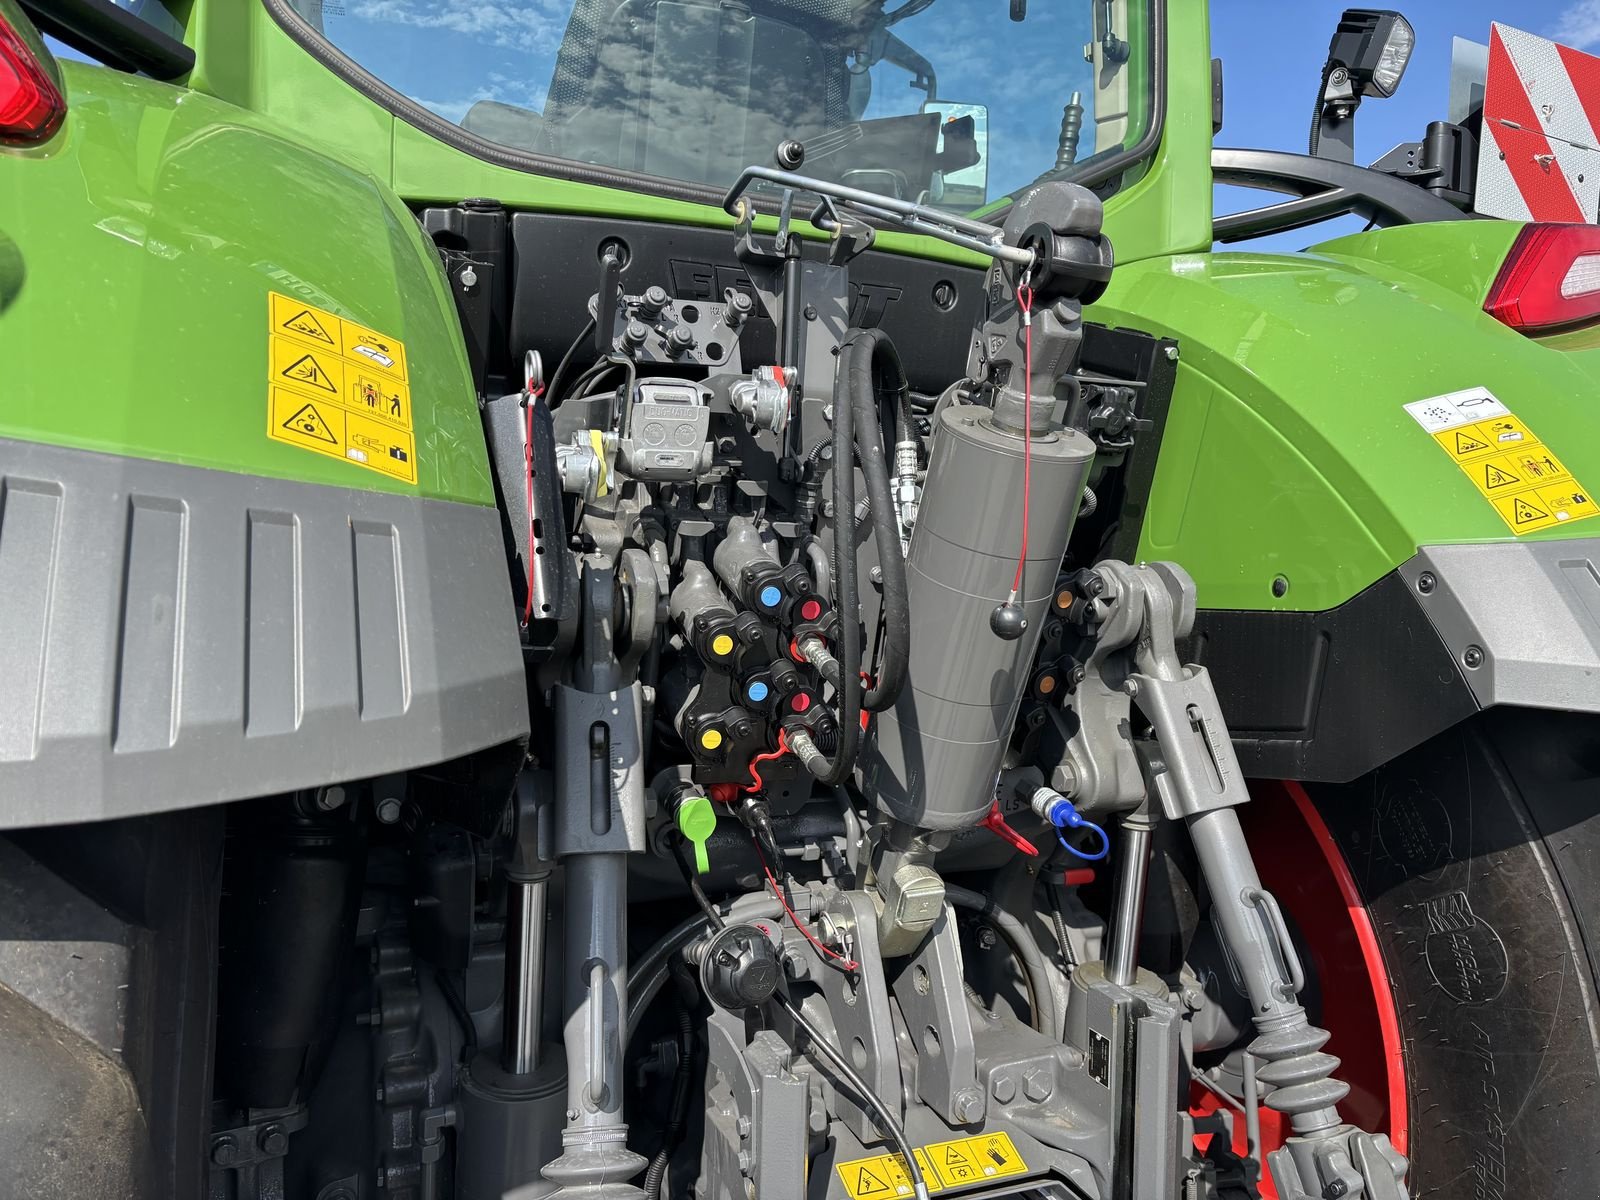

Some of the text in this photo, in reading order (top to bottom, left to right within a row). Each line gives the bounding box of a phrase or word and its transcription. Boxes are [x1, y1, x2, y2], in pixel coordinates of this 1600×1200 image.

[669, 258, 903, 329] FET
[1005, 799, 1020, 811] LS
[1455, 933, 1482, 985] HIGH
[1474, 1149, 1486, 1200] READ
